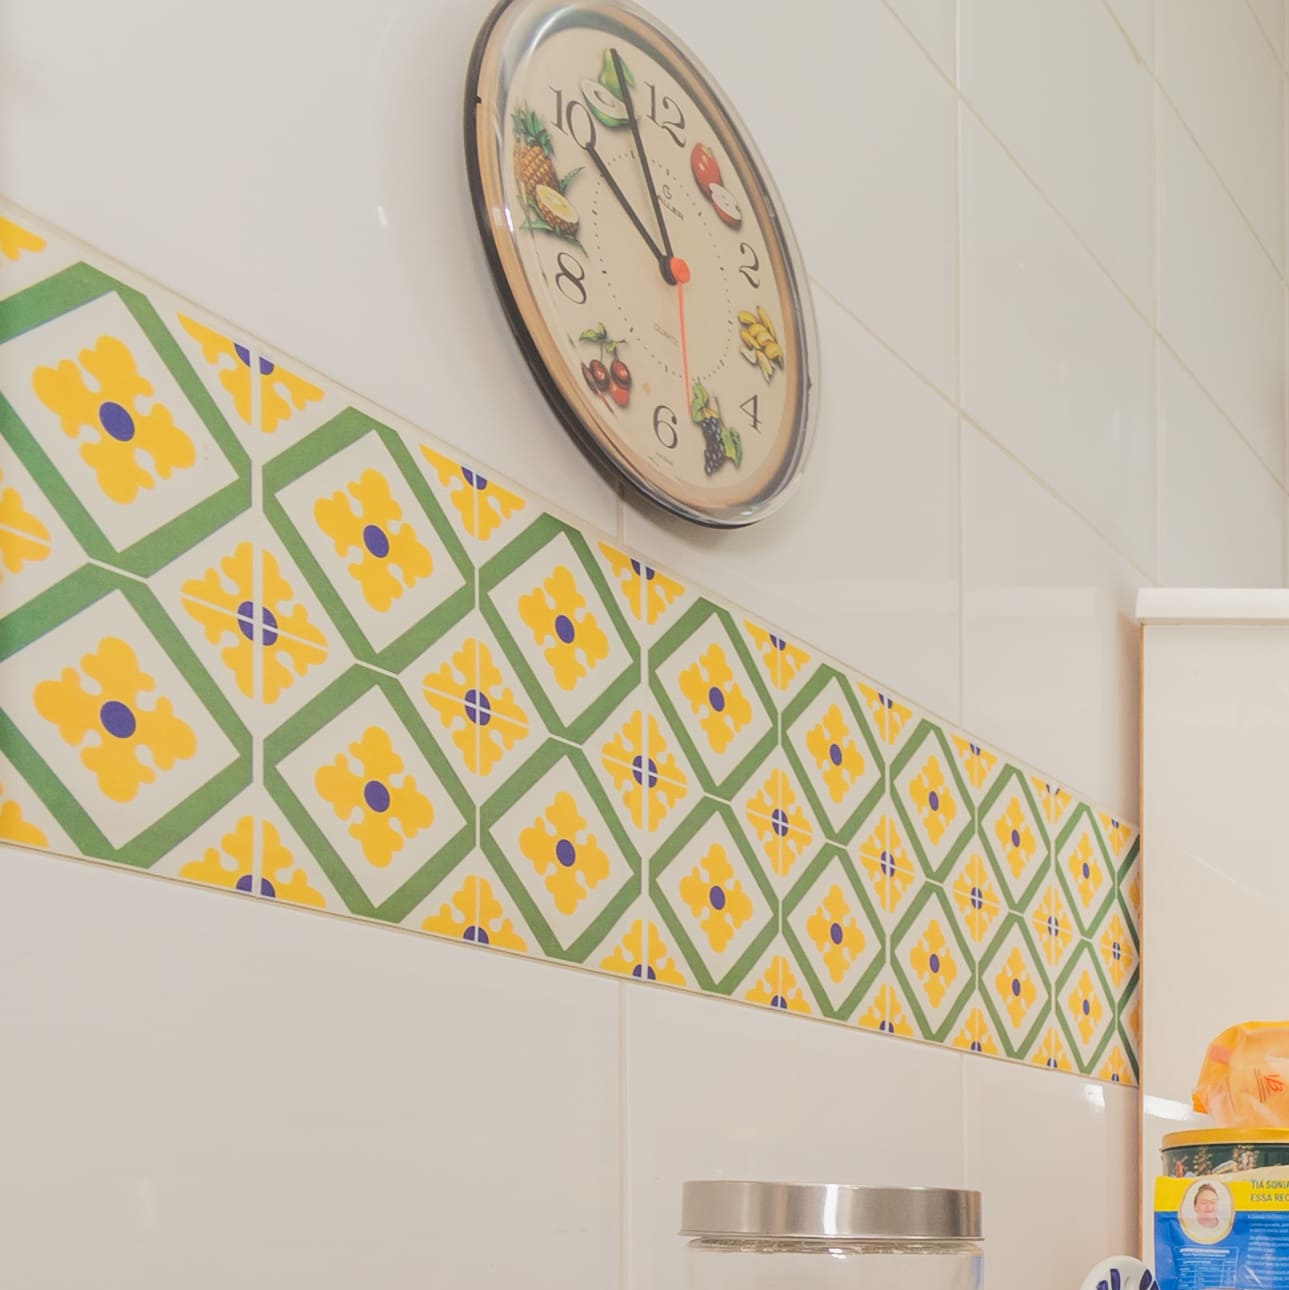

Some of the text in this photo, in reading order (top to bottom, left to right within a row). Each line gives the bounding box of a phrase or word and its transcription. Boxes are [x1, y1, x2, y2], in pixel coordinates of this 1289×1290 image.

[549, 86, 597, 150] 10
[644, 81, 686, 148] 12
[556, 252, 587, 304] 8
[739, 242, 760, 288] 2
[653, 405, 678, 449] 6
[740, 394, 762, 434] 4
[1250, 1179, 1265, 1189] TIA
[1250, 1193, 1272, 1201] ESSA
